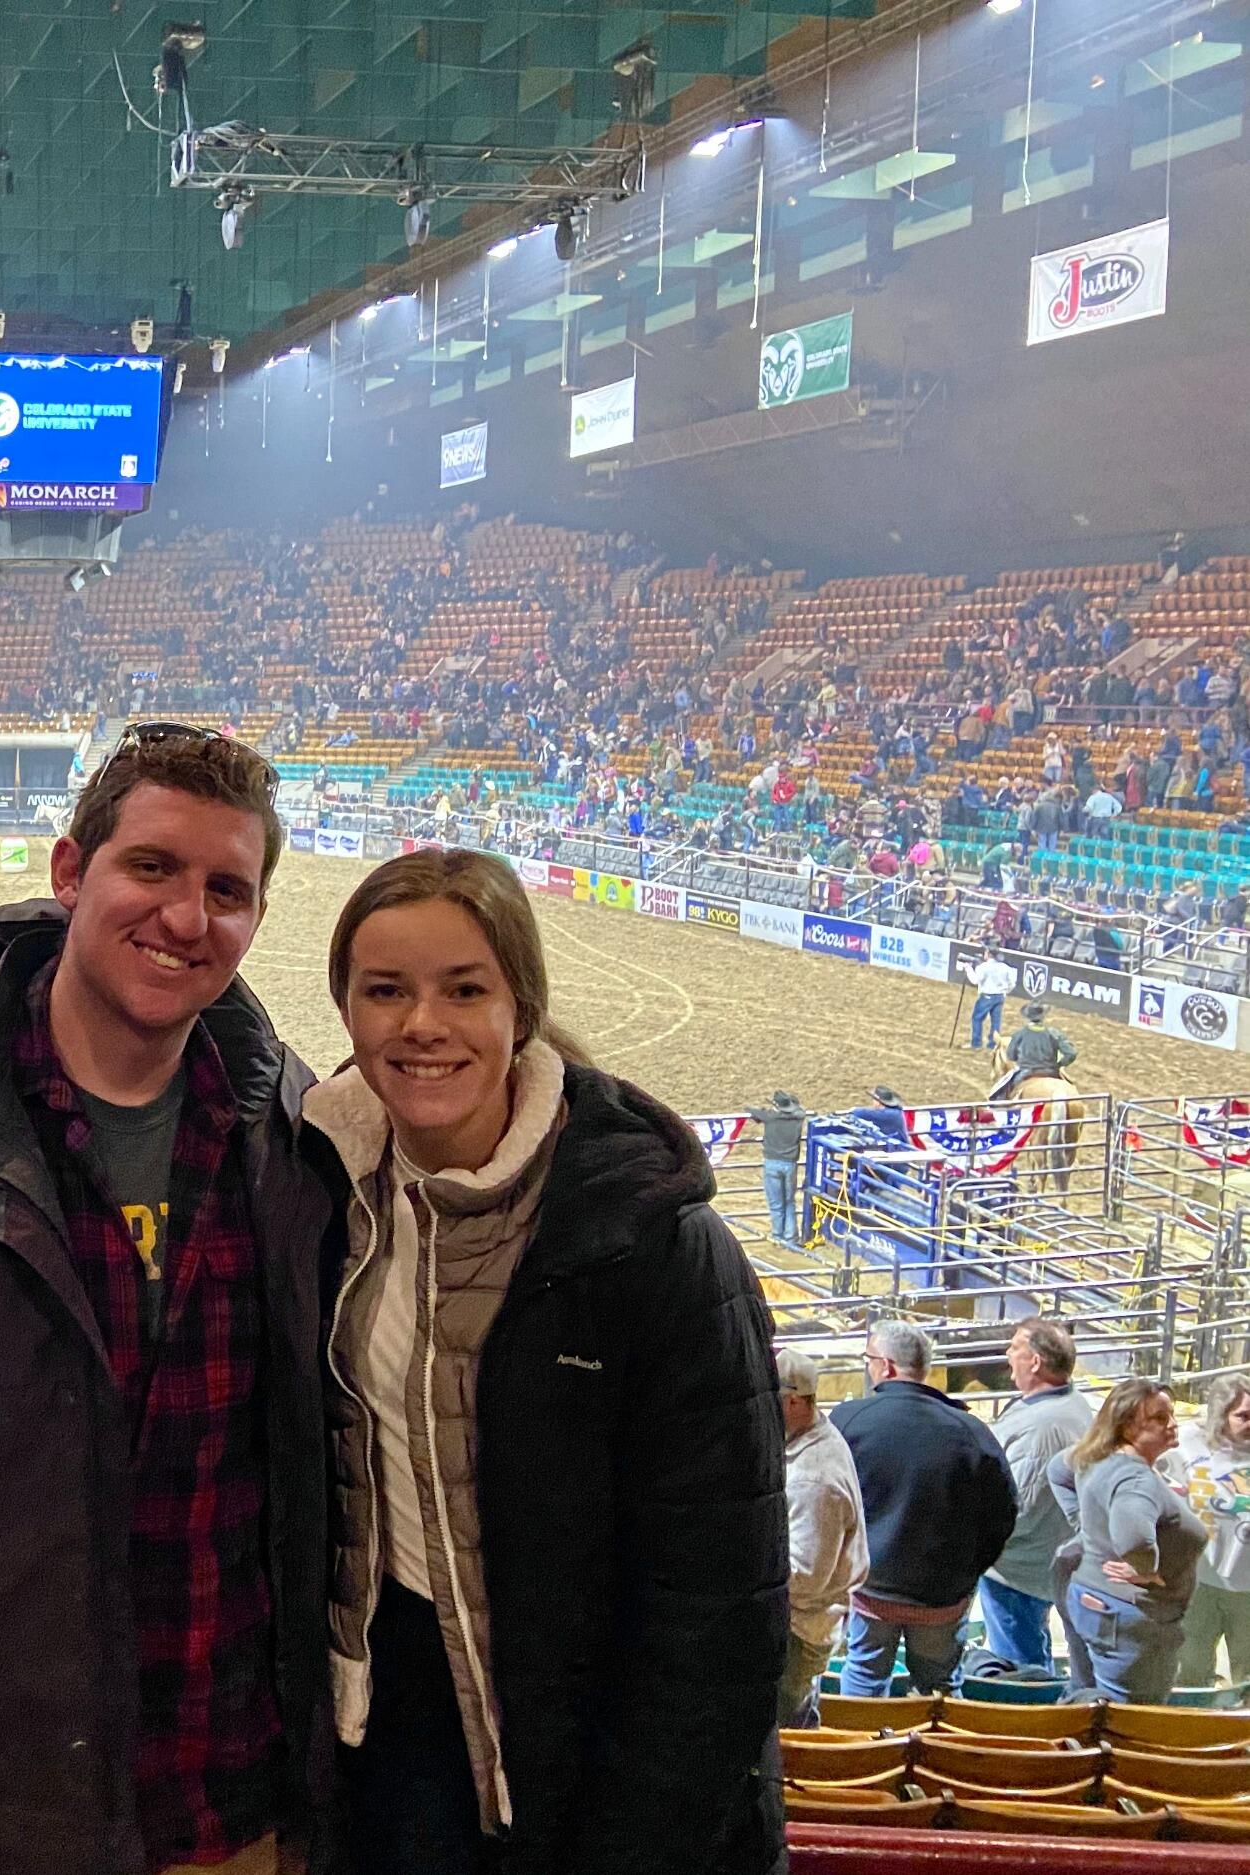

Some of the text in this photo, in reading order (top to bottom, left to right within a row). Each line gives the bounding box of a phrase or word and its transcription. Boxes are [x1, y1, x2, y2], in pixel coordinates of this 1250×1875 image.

[1052, 257, 1134, 324] Justin
[1086, 303, 1116, 319] BOOTS
[22, 402, 132, 418] COLORADO STATE
[22, 416, 98, 430] UNIVERSITY
[10, 485, 116, 500] MONARCH
[654, 887, 679, 905] BOOT
[654, 902, 679, 919] BARN
[707, 907, 738, 925] KYGO
[772, 917, 799, 936] BANK
[811, 924, 845, 948] Coors
[880, 935, 904, 953] B2B
[872, 951, 912, 967] WIRELESS
[1051, 976, 1121, 1005] RAM
